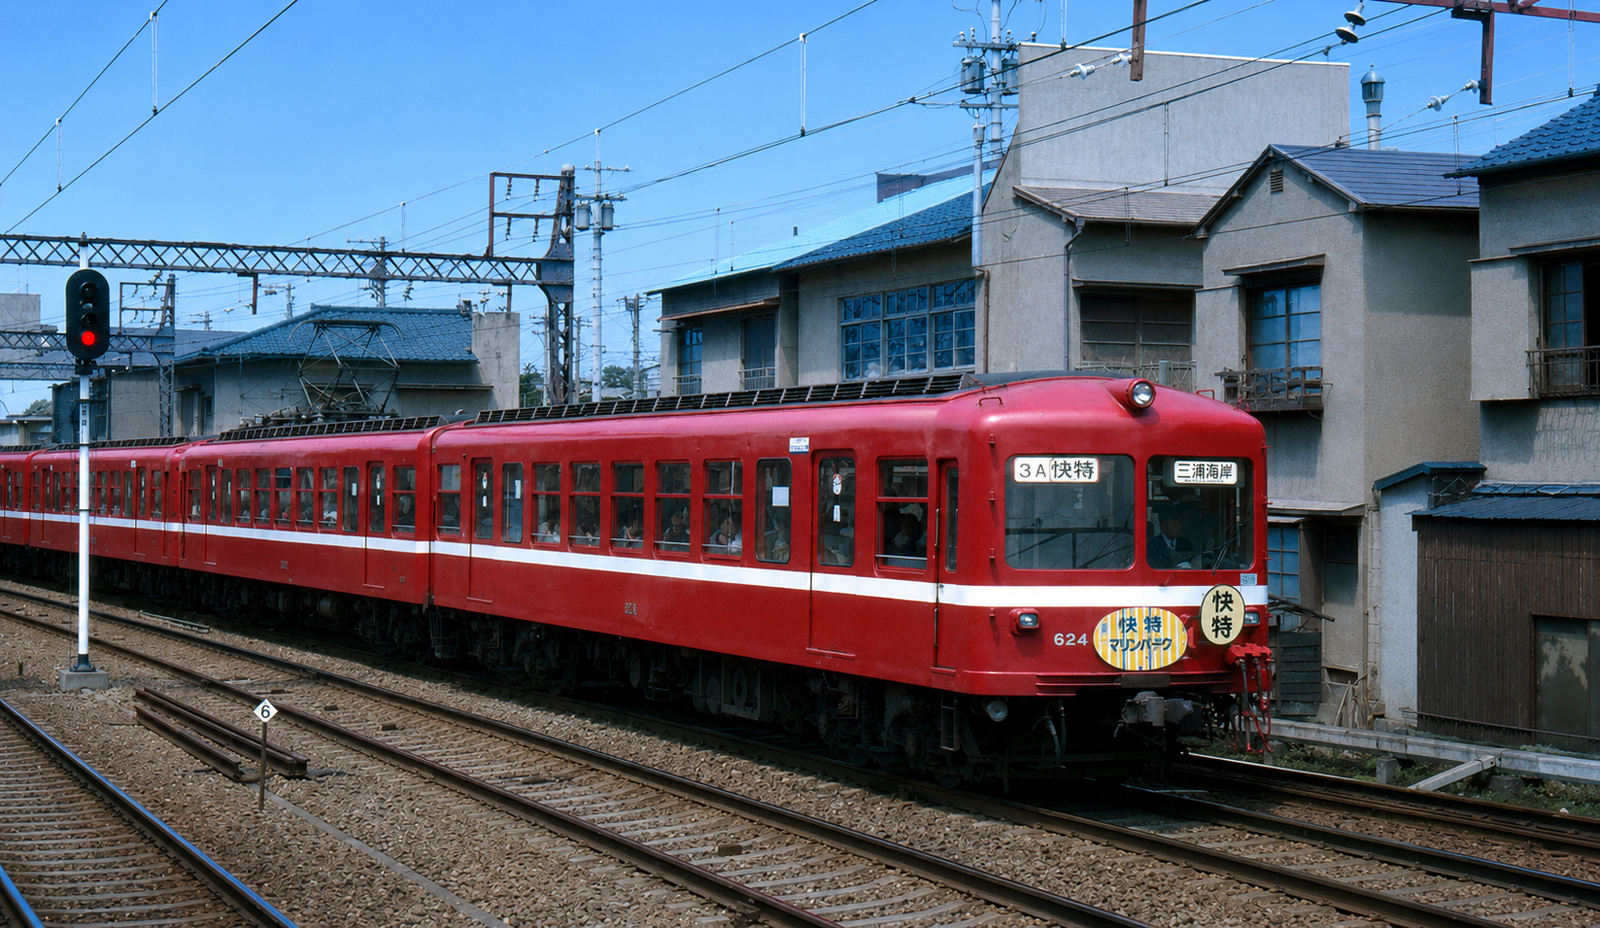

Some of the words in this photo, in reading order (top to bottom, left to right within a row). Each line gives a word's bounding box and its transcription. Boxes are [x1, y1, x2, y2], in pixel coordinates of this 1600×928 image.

[1051, 460, 1095, 481] 快特
[1177, 463, 1233, 479] 三浦海岸
[1211, 590, 1234, 638] 快特
[1053, 632, 1089, 646] 624
[261, 704, 271, 718] 6
